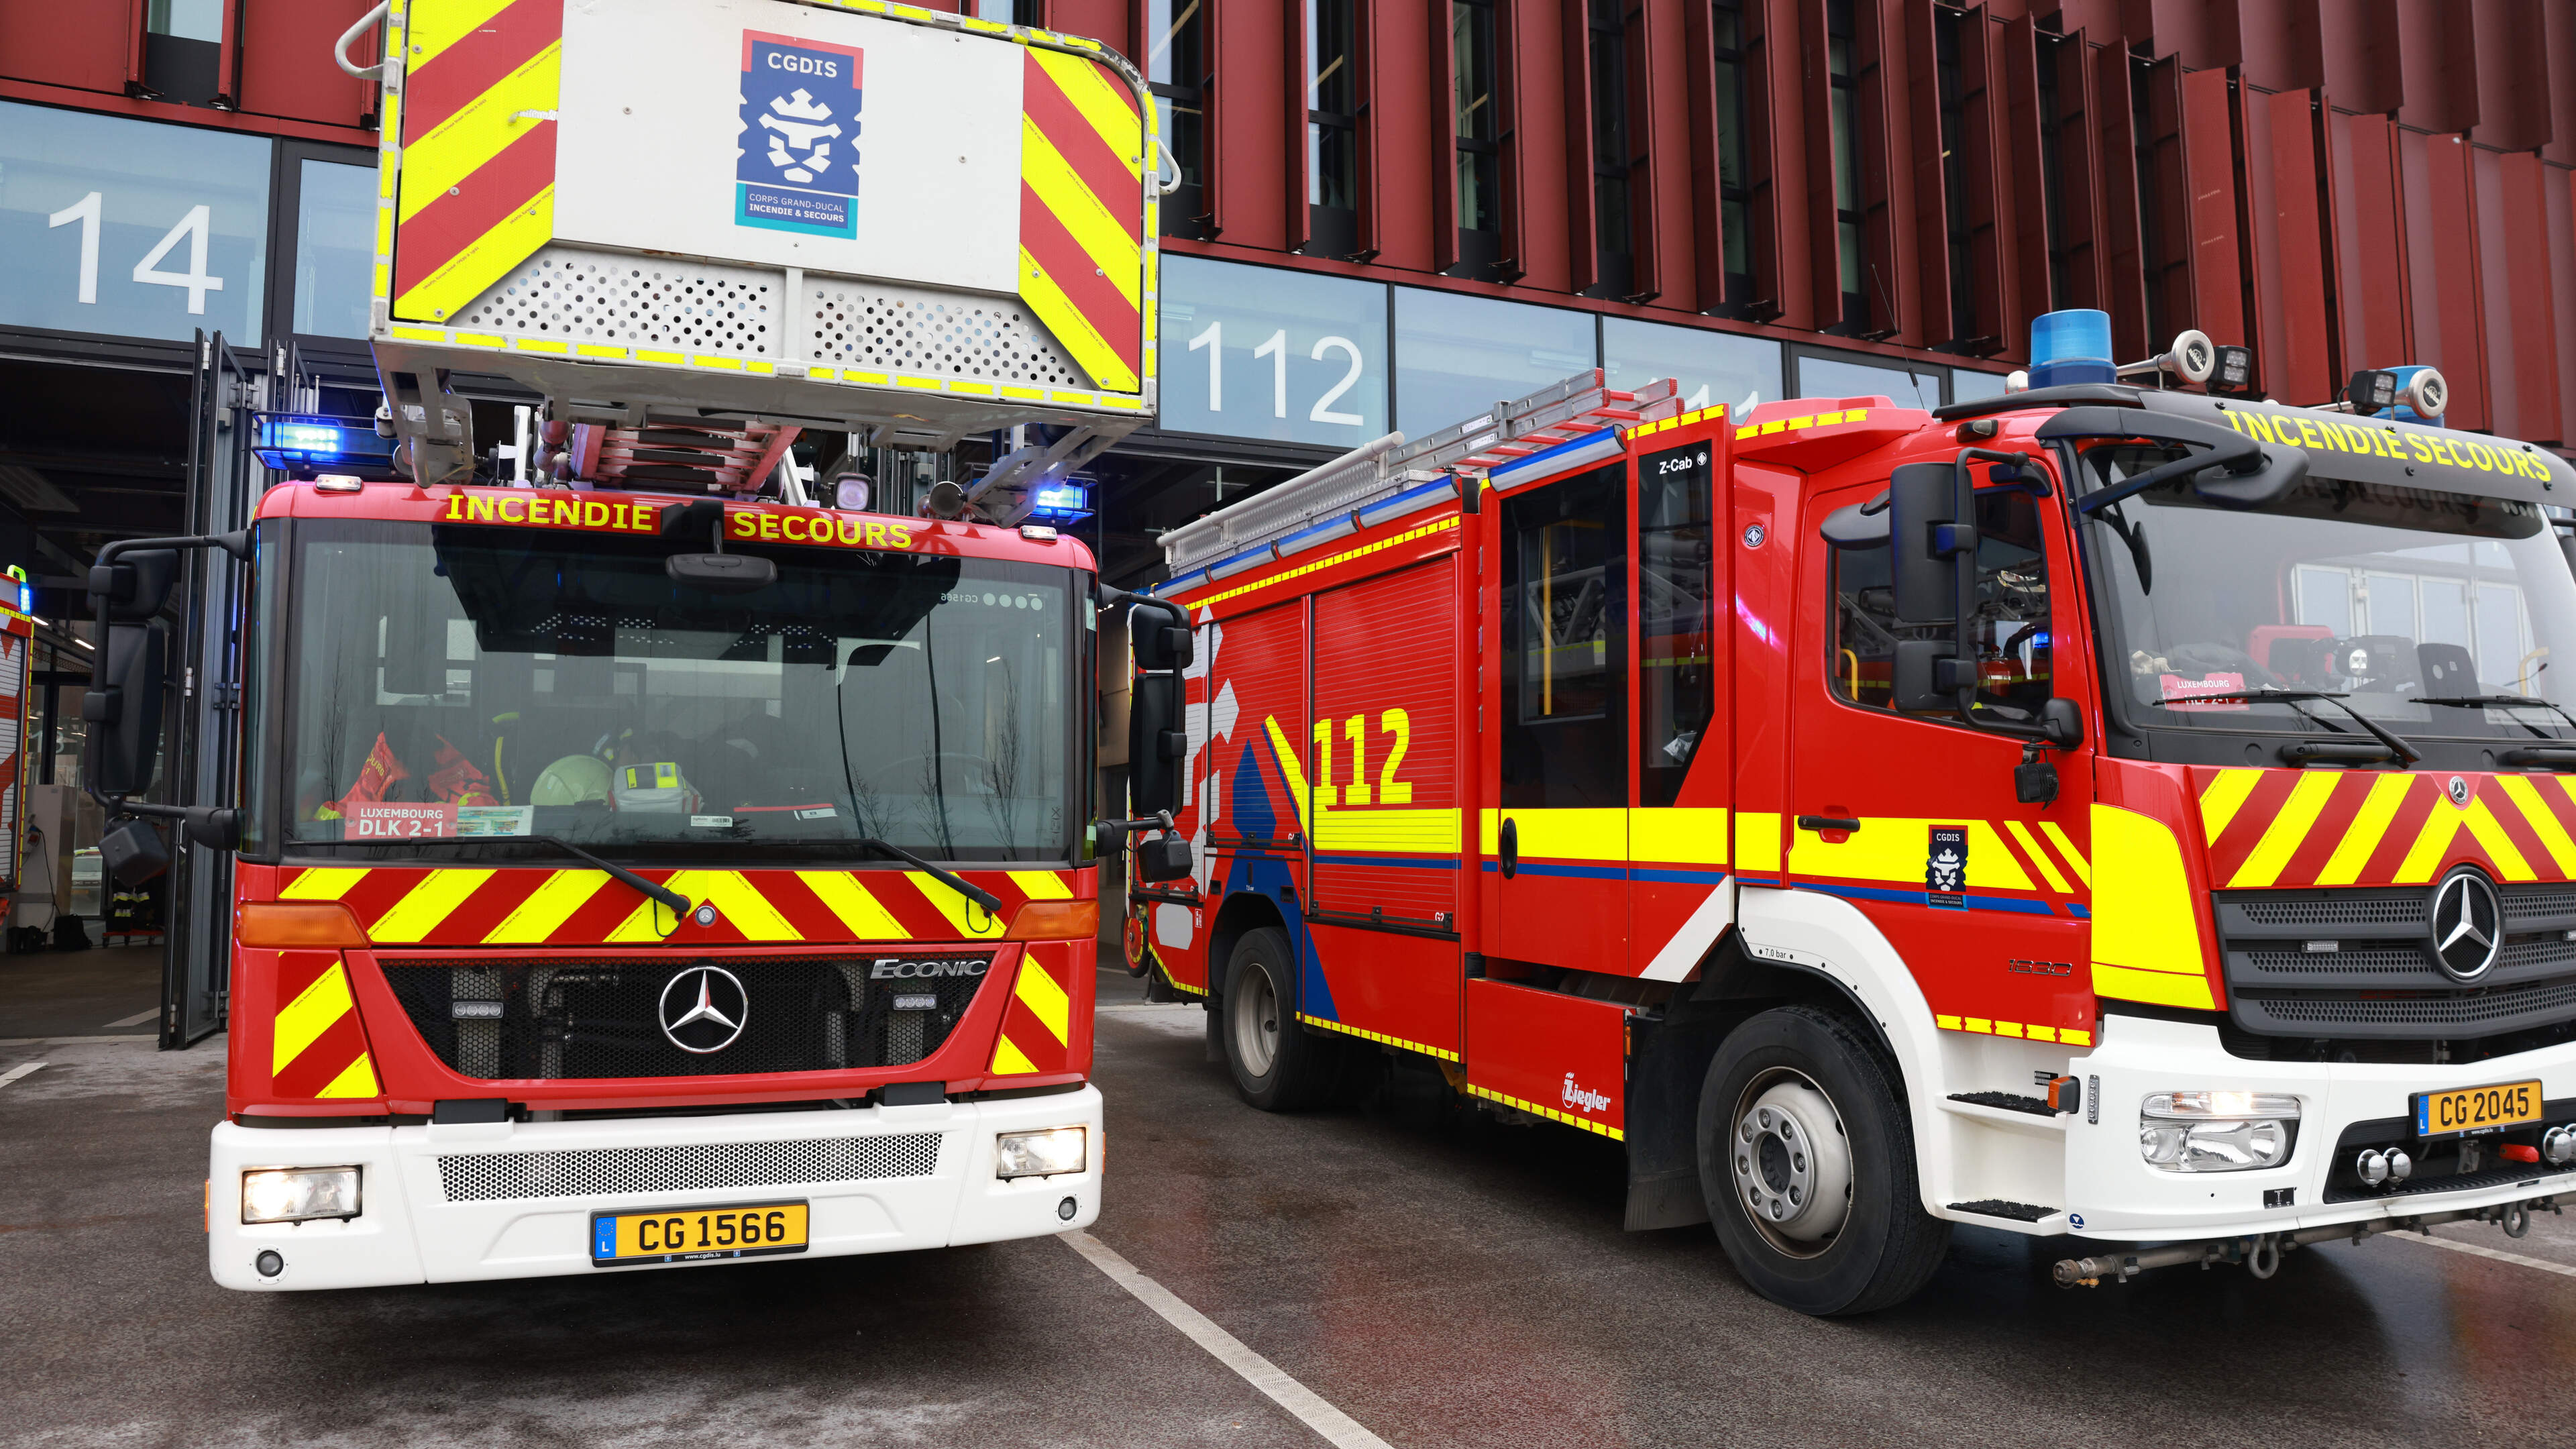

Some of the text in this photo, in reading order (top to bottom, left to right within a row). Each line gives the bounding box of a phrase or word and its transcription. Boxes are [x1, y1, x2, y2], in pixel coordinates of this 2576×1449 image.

[767, 52, 837, 78] CGDIS
[749, 193, 844, 213] CORPS GRAND-DUCAL
[749, 203, 844, 222] INCENDIE & SECOURS
[49, 191, 223, 315] 14
[1189, 321, 1364, 426] 112
[2222, 410, 2552, 482] INCENDIE SECOURS
[1659, 456, 1693, 474] Z-Cab
[446, 494, 912, 549] INCENDIE SECOURS
[2177, 680, 2230, 689] LUXEMBOURG
[1313, 708, 1412, 806] 112
[360, 808, 443, 819] LUXEMBOURG
[359, 819, 443, 837] DLK 2-1
[1936, 833, 1960, 842] CGDIS
[1776, 949, 1786, 958] bar
[2008, 959, 2072, 976] 1630
[1562, 1077, 1611, 1112] Ziegler
[2440, 1087, 2528, 1126] CG 2045
[2420, 1118, 2425, 1129] L
[639, 1211, 785, 1251] CG 1566
[602, 1241, 609, 1252] L
[684, 1252, 721, 1260] www.cgdis.lu
